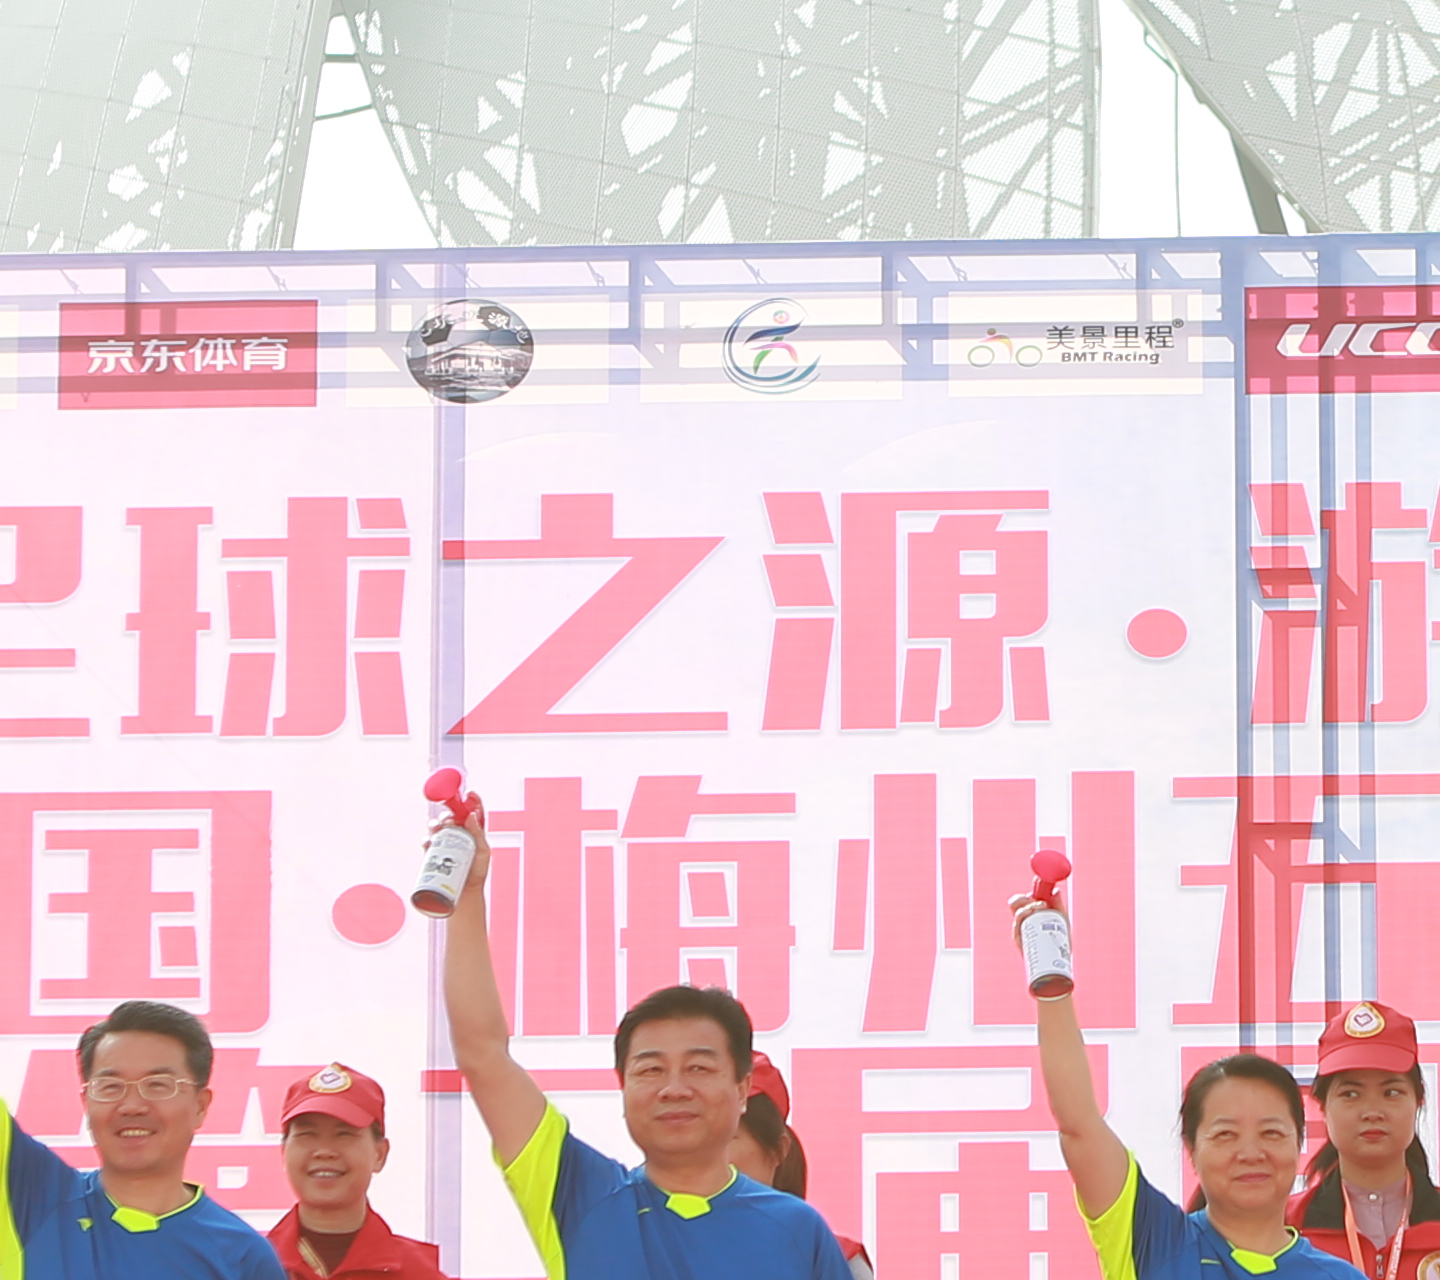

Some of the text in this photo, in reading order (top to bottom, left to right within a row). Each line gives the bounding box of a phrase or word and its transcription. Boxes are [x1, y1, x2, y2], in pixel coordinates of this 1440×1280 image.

[1046, 324, 1175, 351] 美景里程
[87, 337, 290, 374] 京东体育
[1061, 350, 1160, 365] BMT Racing
